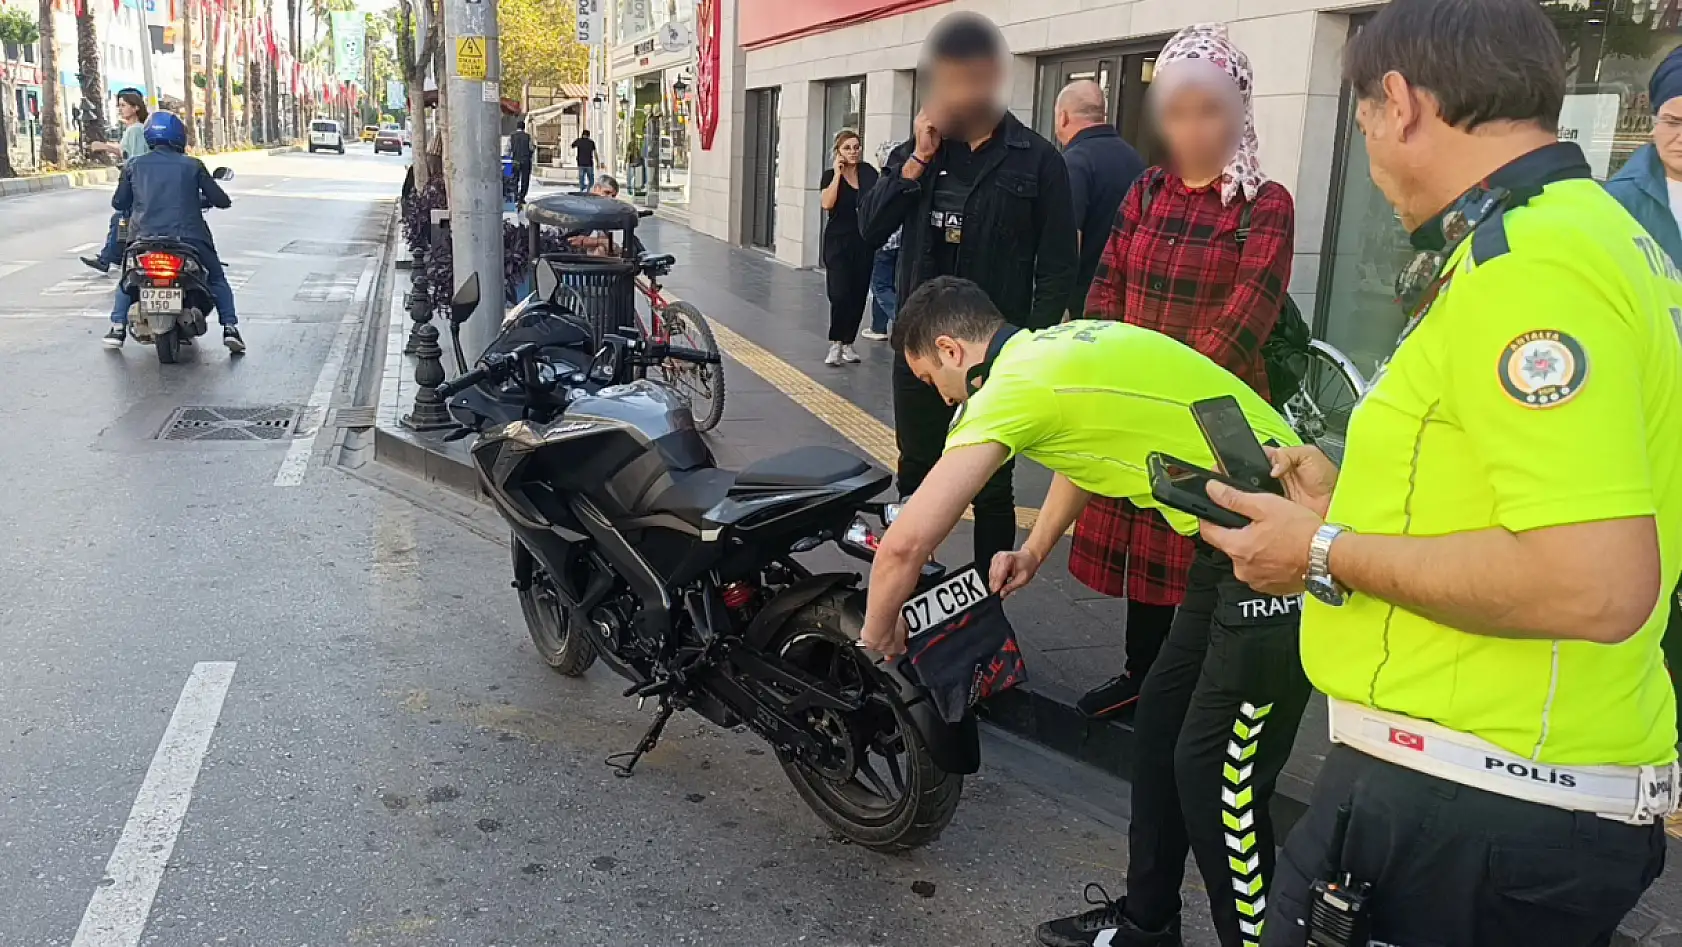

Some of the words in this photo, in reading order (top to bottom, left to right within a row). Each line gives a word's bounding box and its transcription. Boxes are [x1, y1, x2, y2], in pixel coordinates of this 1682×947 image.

[143, 290, 156, 299] 07
[159, 290, 181, 299] CBM
[150, 301, 170, 310] 150
[902, 597, 931, 632] 07
[936, 573, 984, 614] CBK
[1238, 594, 1304, 617] TRAFI
[1485, 756, 1577, 788] POLİS
